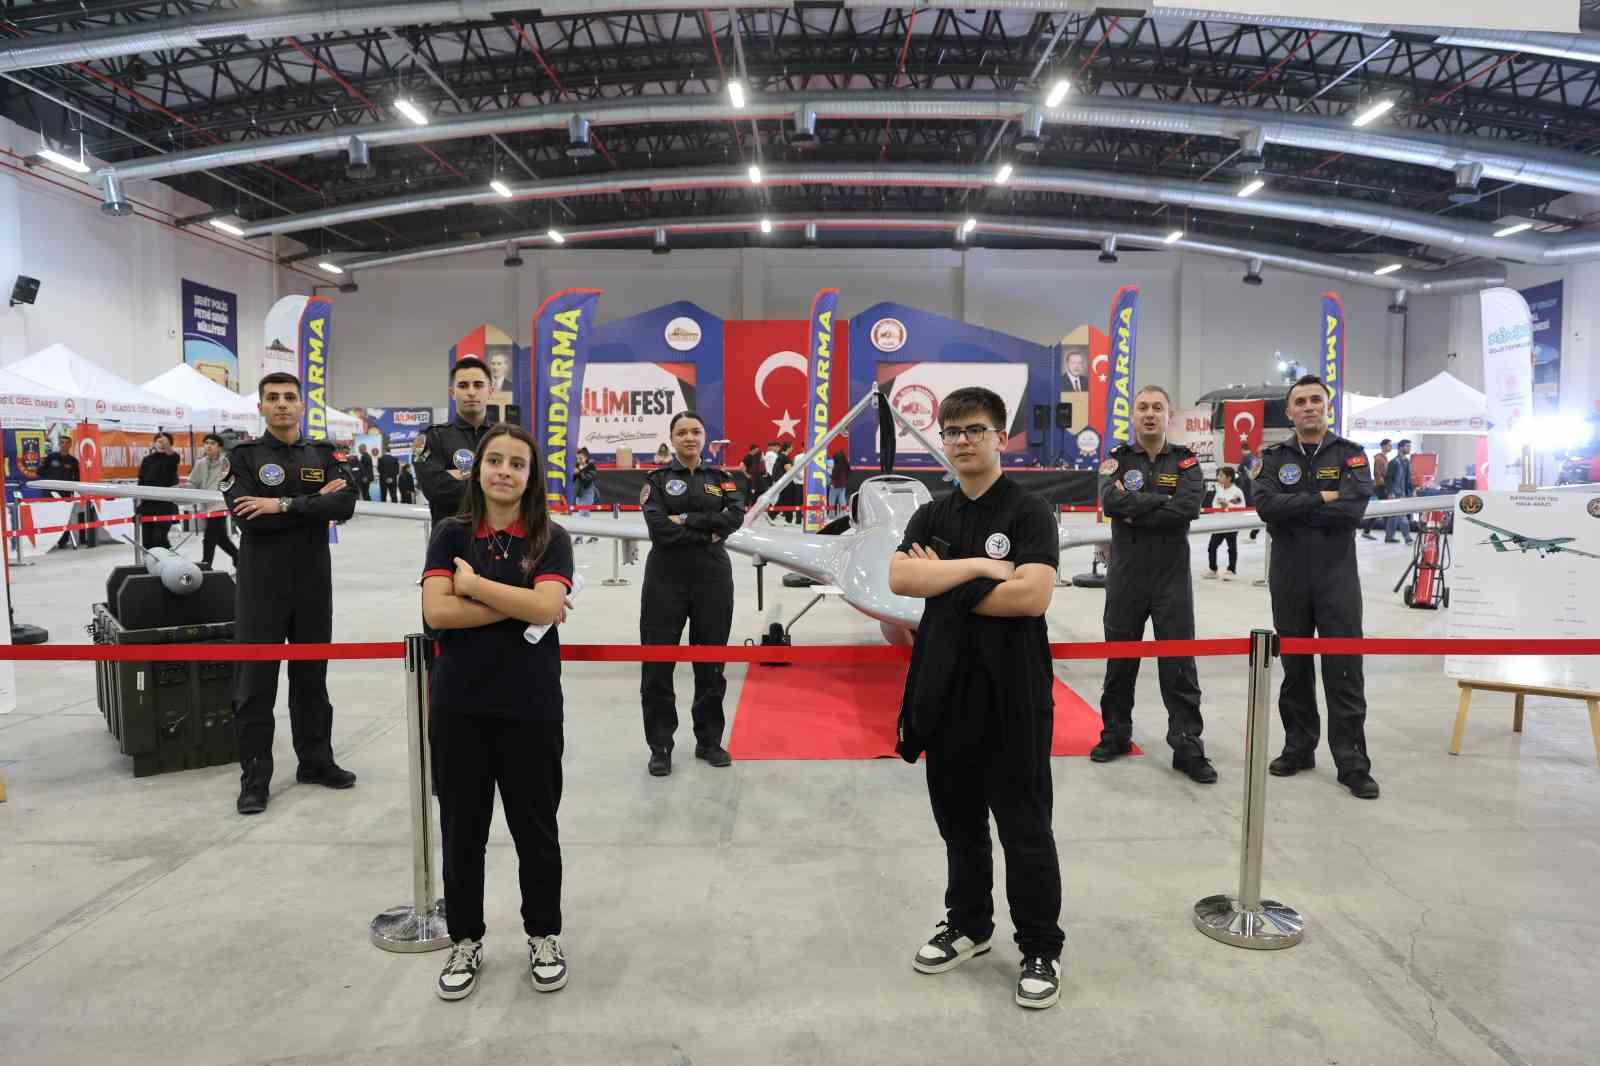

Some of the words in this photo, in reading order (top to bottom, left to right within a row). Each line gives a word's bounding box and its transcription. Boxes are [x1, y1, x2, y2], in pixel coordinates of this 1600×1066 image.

[547, 309, 581, 487] JANDARMA
[580, 387, 676, 416] İLİMFEST
[812, 310, 833, 487] JANDARMA
